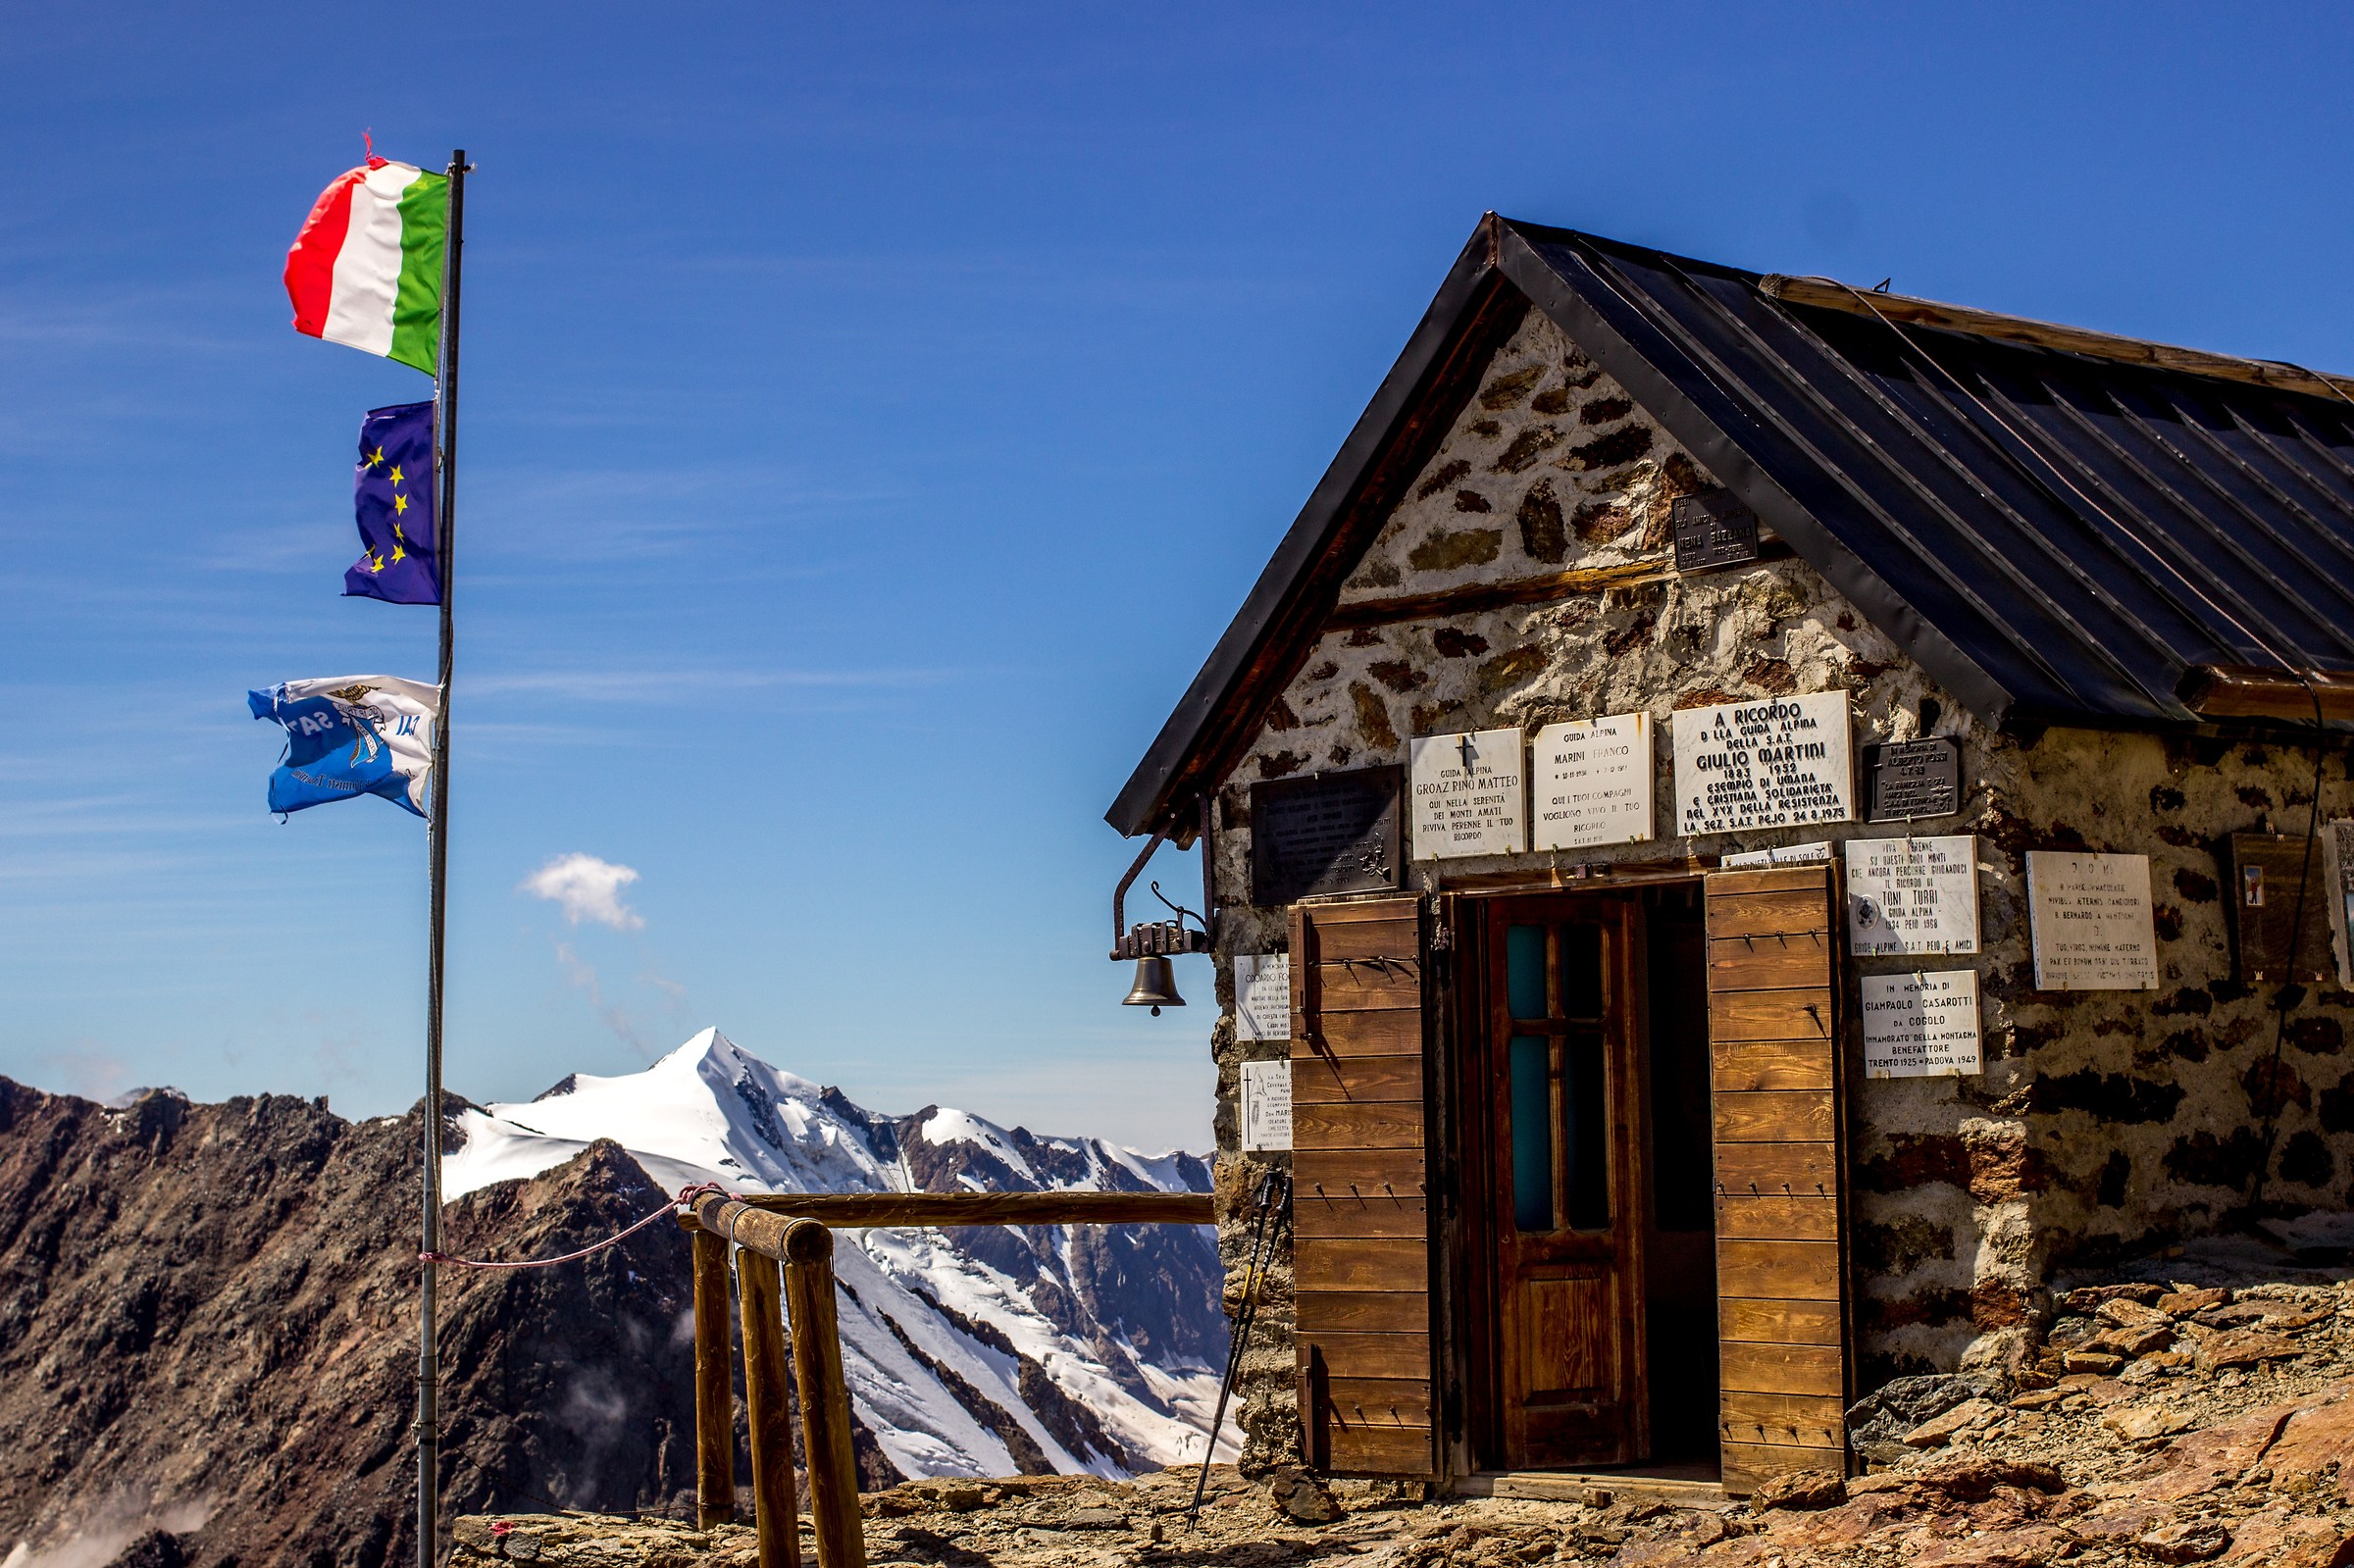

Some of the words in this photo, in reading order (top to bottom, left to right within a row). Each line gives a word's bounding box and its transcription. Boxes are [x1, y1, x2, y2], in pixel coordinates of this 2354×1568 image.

[1715, 712, 1725, 728] A
[1735, 703, 1801, 725] RICORDO
[1563, 733, 1586, 742] GUIDA
[1591, 728, 1616, 738] ALPINA
[1701, 729, 1732, 741] DLLA
[1741, 724, 1770, 735] GUIDA
[1780, 718, 1817, 732] ALPINA
[1726, 737, 1758, 749] DELLA
[1555, 751, 1585, 764] MARINI
[1593, 745, 1629, 759] FRANCO
[1697, 751, 1749, 771] GIULIO
[1759, 742, 1825, 764] MARTINI
[1888, 754, 1923, 767] ALBERTO
[1925, 752, 1947, 763] ROSSI
[1441, 769, 1461, 778] GUIDA
[1467, 767, 1492, 776] ALPINA
[1724, 768, 1751, 780] 1883
[1769, 763, 1797, 775] 1952
[1416, 782, 1449, 795] GROAZ
[1453, 780, 1474, 791] RINO
[1478, 776, 1517, 789] MATTEO
[1707, 780, 1752, 793] ESEMPIO
[1760, 778, 1769, 788] DI
[1447, 799, 1467, 808] NELLA
[1552, 796, 1565, 805] QUI
[1573, 793, 1590, 803] TUOI
[1592, 788, 1632, 800] COMPAGNI
[1740, 802, 1771, 814] DELLA
[1779, 794, 1839, 809] RESISTENZA
[1450, 810, 1471, 819] MONTI
[1478, 807, 1502, 817] AMATI
[1543, 809, 1581, 821] VOGLIONO
[1625, 802, 1640, 812] TUO
[1423, 824, 1446, 833] RIVIVA
[1452, 821, 1481, 831] PERENNE
[1684, 822, 1696, 833] LA
[1759, 812, 1786, 825] PEJO
[1793, 811, 1807, 822] 24
[1822, 807, 1845, 819] 1975
[1870, 856, 1878, 866] SU
[1883, 854, 1903, 865] QUESTI
[1928, 852, 1946, 863] MONTI
[1868, 867, 1890, 878] ANCORA
[1897, 879, 1921, 887] RICORDO
[1882, 891, 1901, 906] TONI
[1913, 889, 1937, 905] TURRI
[1888, 908, 1906, 918] GUIDA
[1912, 907, 1933, 917] ALPINA
[1905, 920, 1919, 930] PEIO
[1924, 919, 1938, 929] 1968
[1855, 942, 1870, 953] GUIDE
[1955, 940, 1972, 950] AMICI
[1904, 983, 1937, 992] MEMORIA
[1866, 1000, 1913, 1011] GIAMPAOLO
[1922, 996, 1972, 1008] CASAROTTI
[1909, 1016, 1945, 1026] COGOLO
[1867, 1035, 1910, 1043] INNAMORATO
[1941, 1032, 1976, 1040] MONTAGNA
[1892, 1044, 1949, 1054] BENEFATTORE
[1958, 1055, 1976, 1064] 1949
